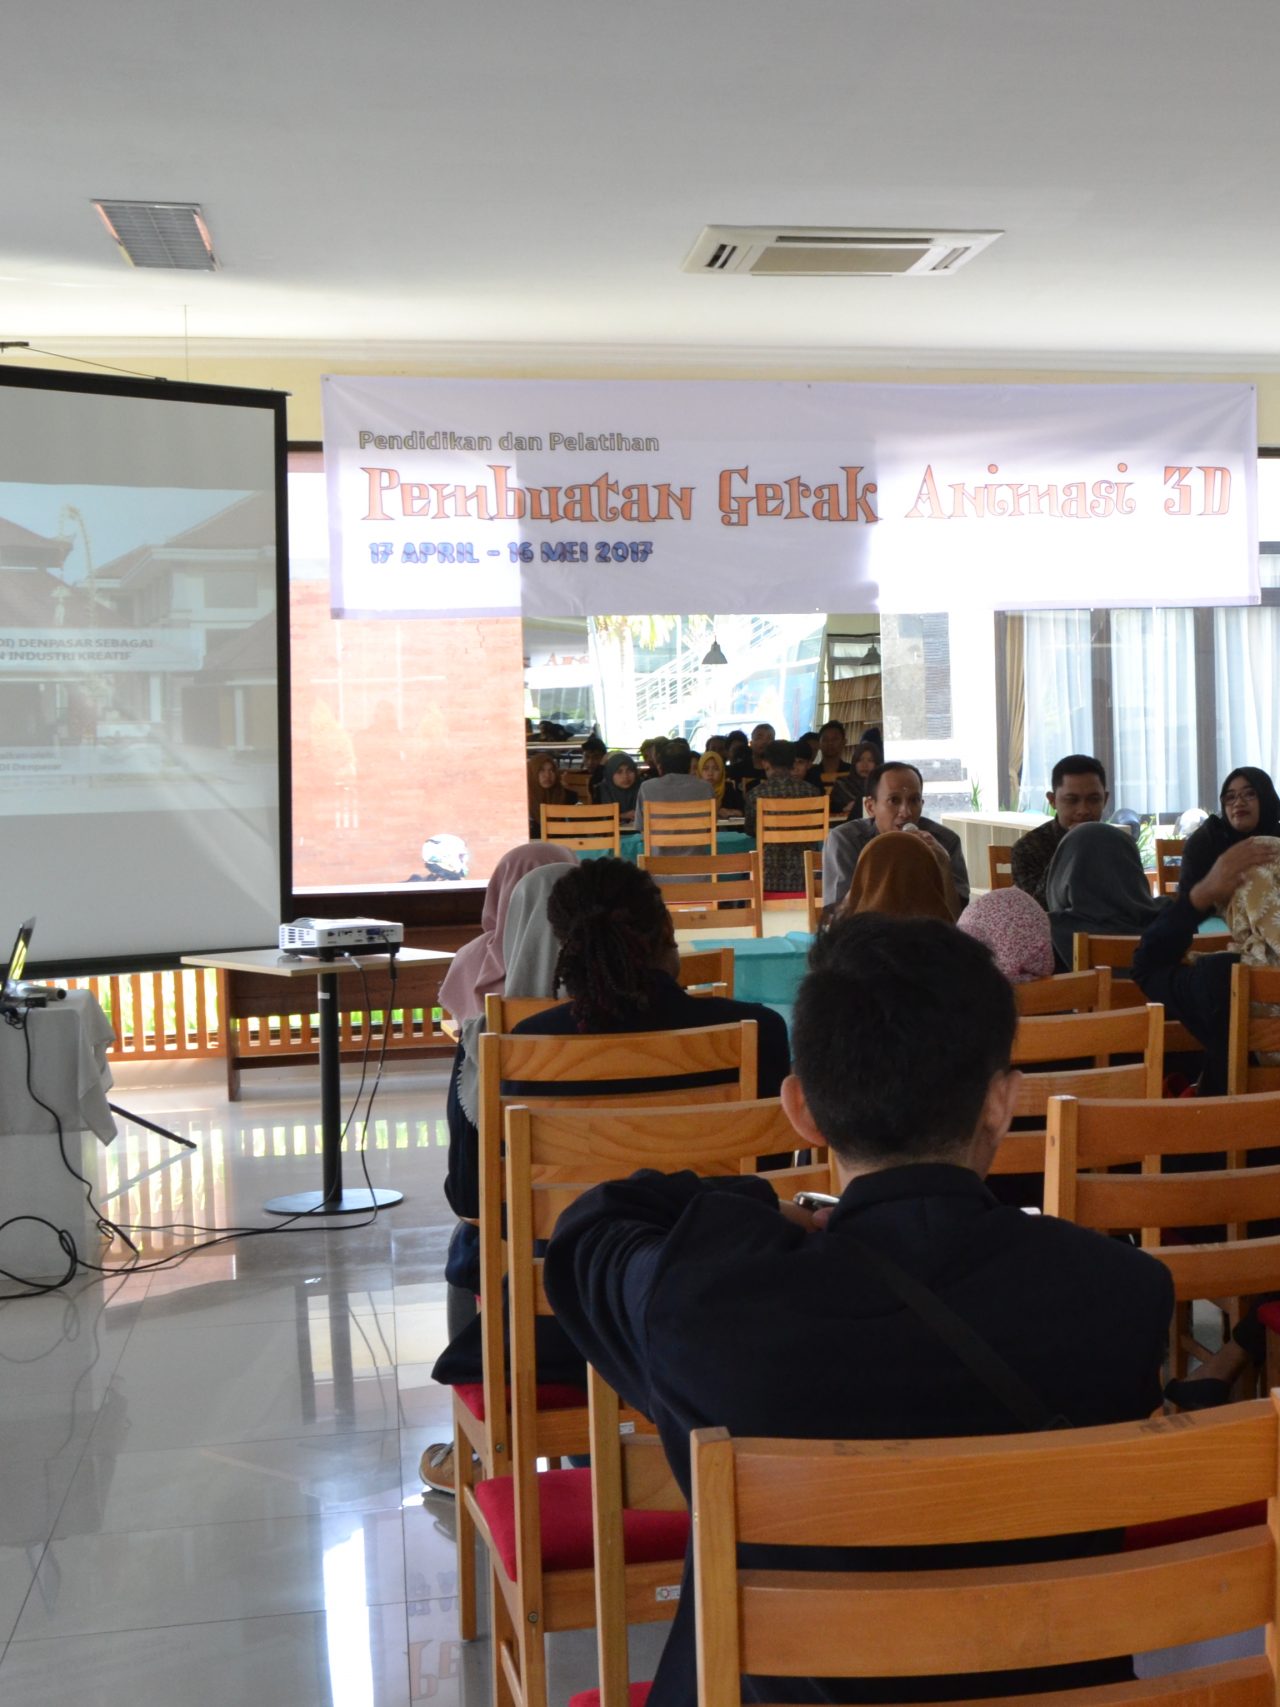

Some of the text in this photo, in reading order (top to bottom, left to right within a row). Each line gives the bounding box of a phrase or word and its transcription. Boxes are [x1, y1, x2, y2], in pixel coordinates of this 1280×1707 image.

[358, 430, 660, 452] Pendidikan dan Pelatihan
[360, 462, 1232, 527] Pembuatan Gerak Animasi 3D
[369, 541, 654, 564] 17 APRIL - 16 MEI 2017
[18, 638, 94, 649] DENPASAR
[95, 638, 154, 649] SEBAGAI
[8, 650, 75, 661] INDUSTRI
[78, 650, 132, 661] KREATIF
